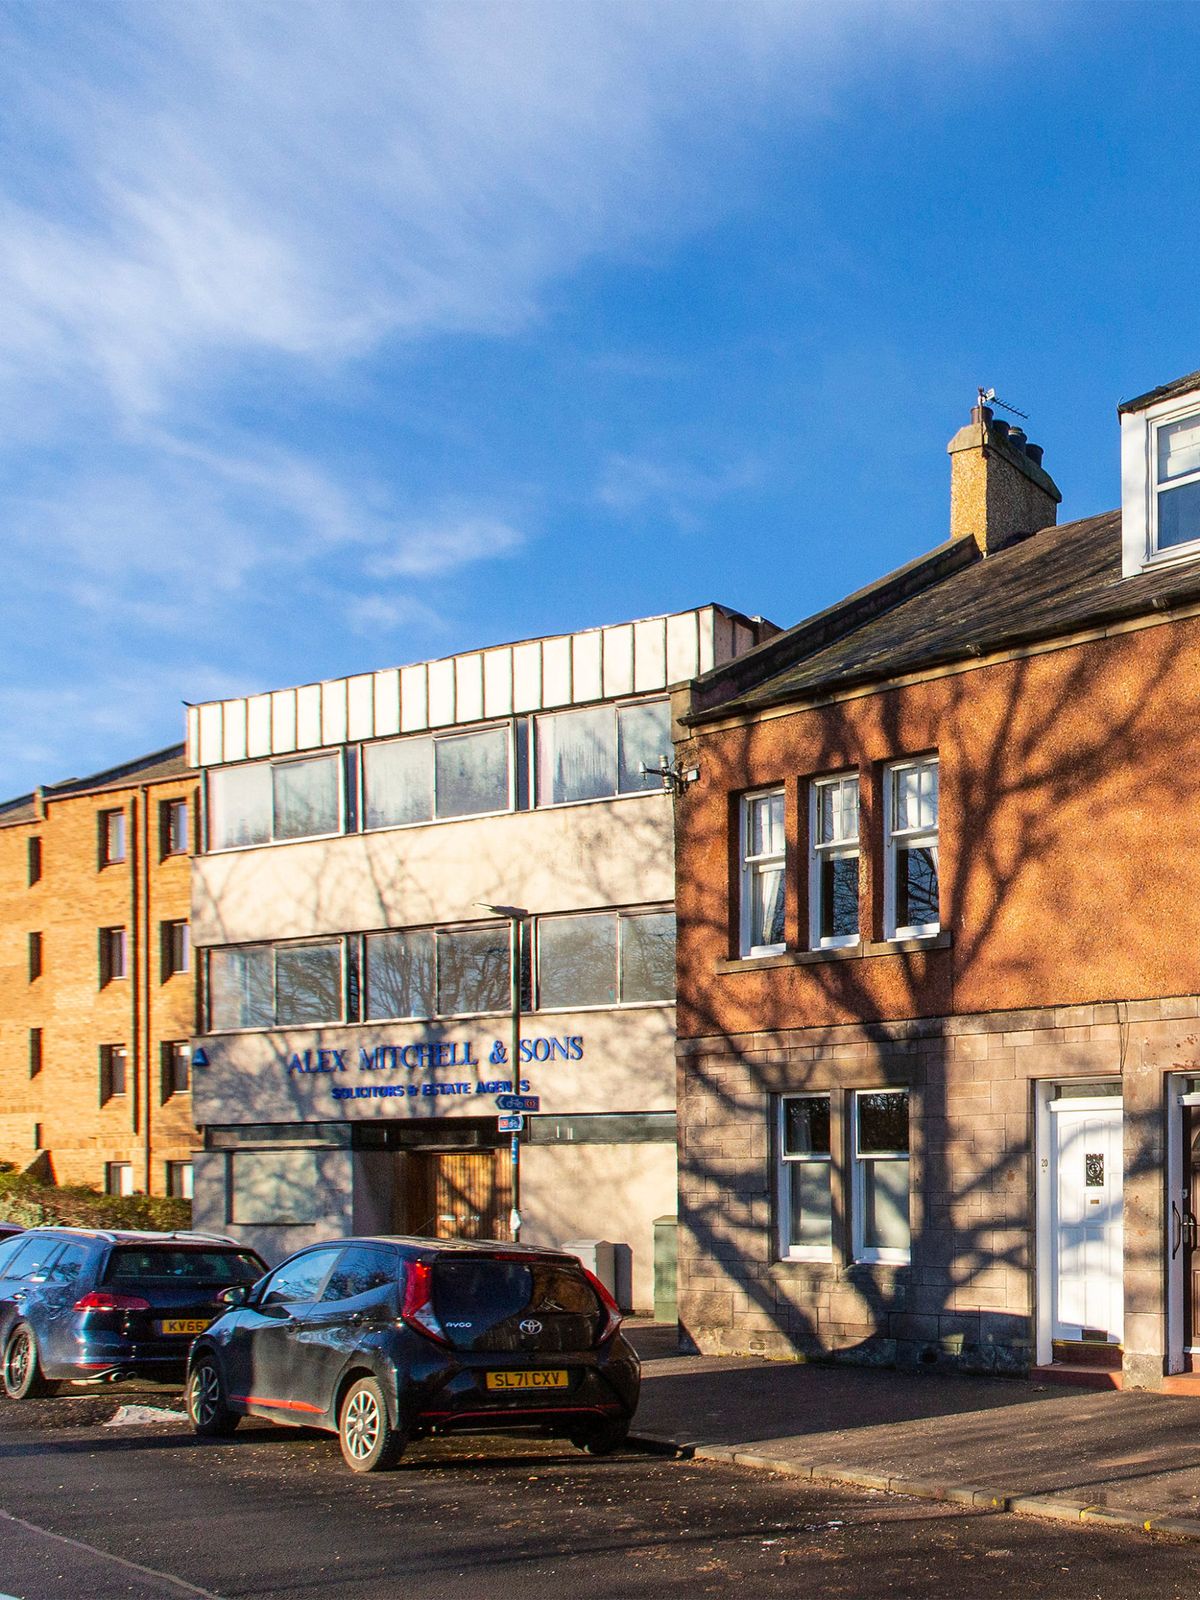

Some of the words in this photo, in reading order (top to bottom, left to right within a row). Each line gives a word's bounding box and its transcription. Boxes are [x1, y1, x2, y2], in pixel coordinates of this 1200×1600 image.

[288, 1048, 348, 1074] ALEX
[359, 1041, 478, 1071] MITCHELL
[489, 1040, 508, 1064] &
[519, 1036, 584, 1063] SONS
[331, 1085, 404, 1099] SOLICITORS
[407, 1084, 419, 1097] &
[422, 1081, 472, 1097] ESTATE
[475, 1079, 531, 1094] AGENS
[1041, 1158, 1049, 1167] 20
[494, 1373, 529, 1387] SL71
[532, 1372, 560, 1385] CXV
